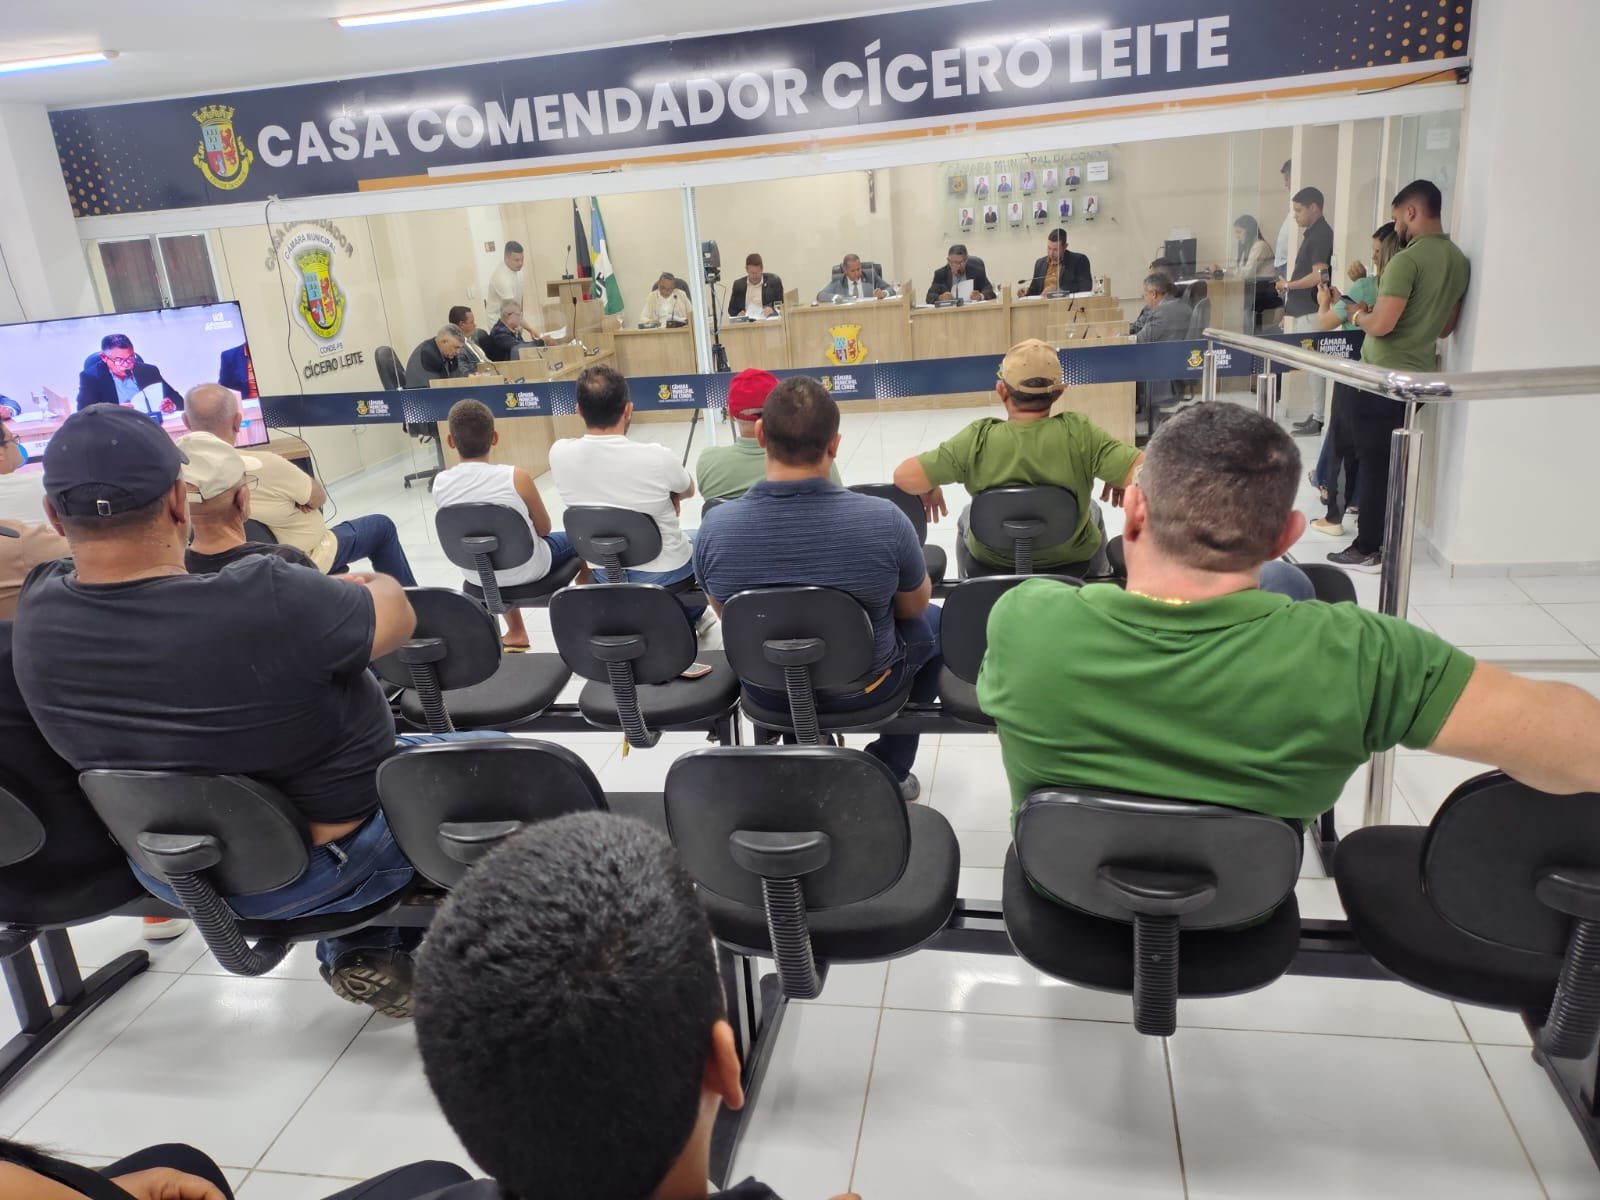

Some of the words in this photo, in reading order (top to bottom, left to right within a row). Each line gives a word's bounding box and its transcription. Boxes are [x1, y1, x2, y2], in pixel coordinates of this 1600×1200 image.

[257, 112, 400, 167] CASA
[407, 67, 809, 153] COMENDADOR
[822, 38, 1052, 110] CÍCERO
[1069, 15, 1230, 83] LEITE
[306, 232, 337, 255] MUNICIPAL
[1320, 337, 1347, 346] CÂMARA
[1320, 344, 1354, 352] MUNICIPAL
[304, 359, 339, 379] CÍCERO
[339, 351, 364, 368] LEITE
